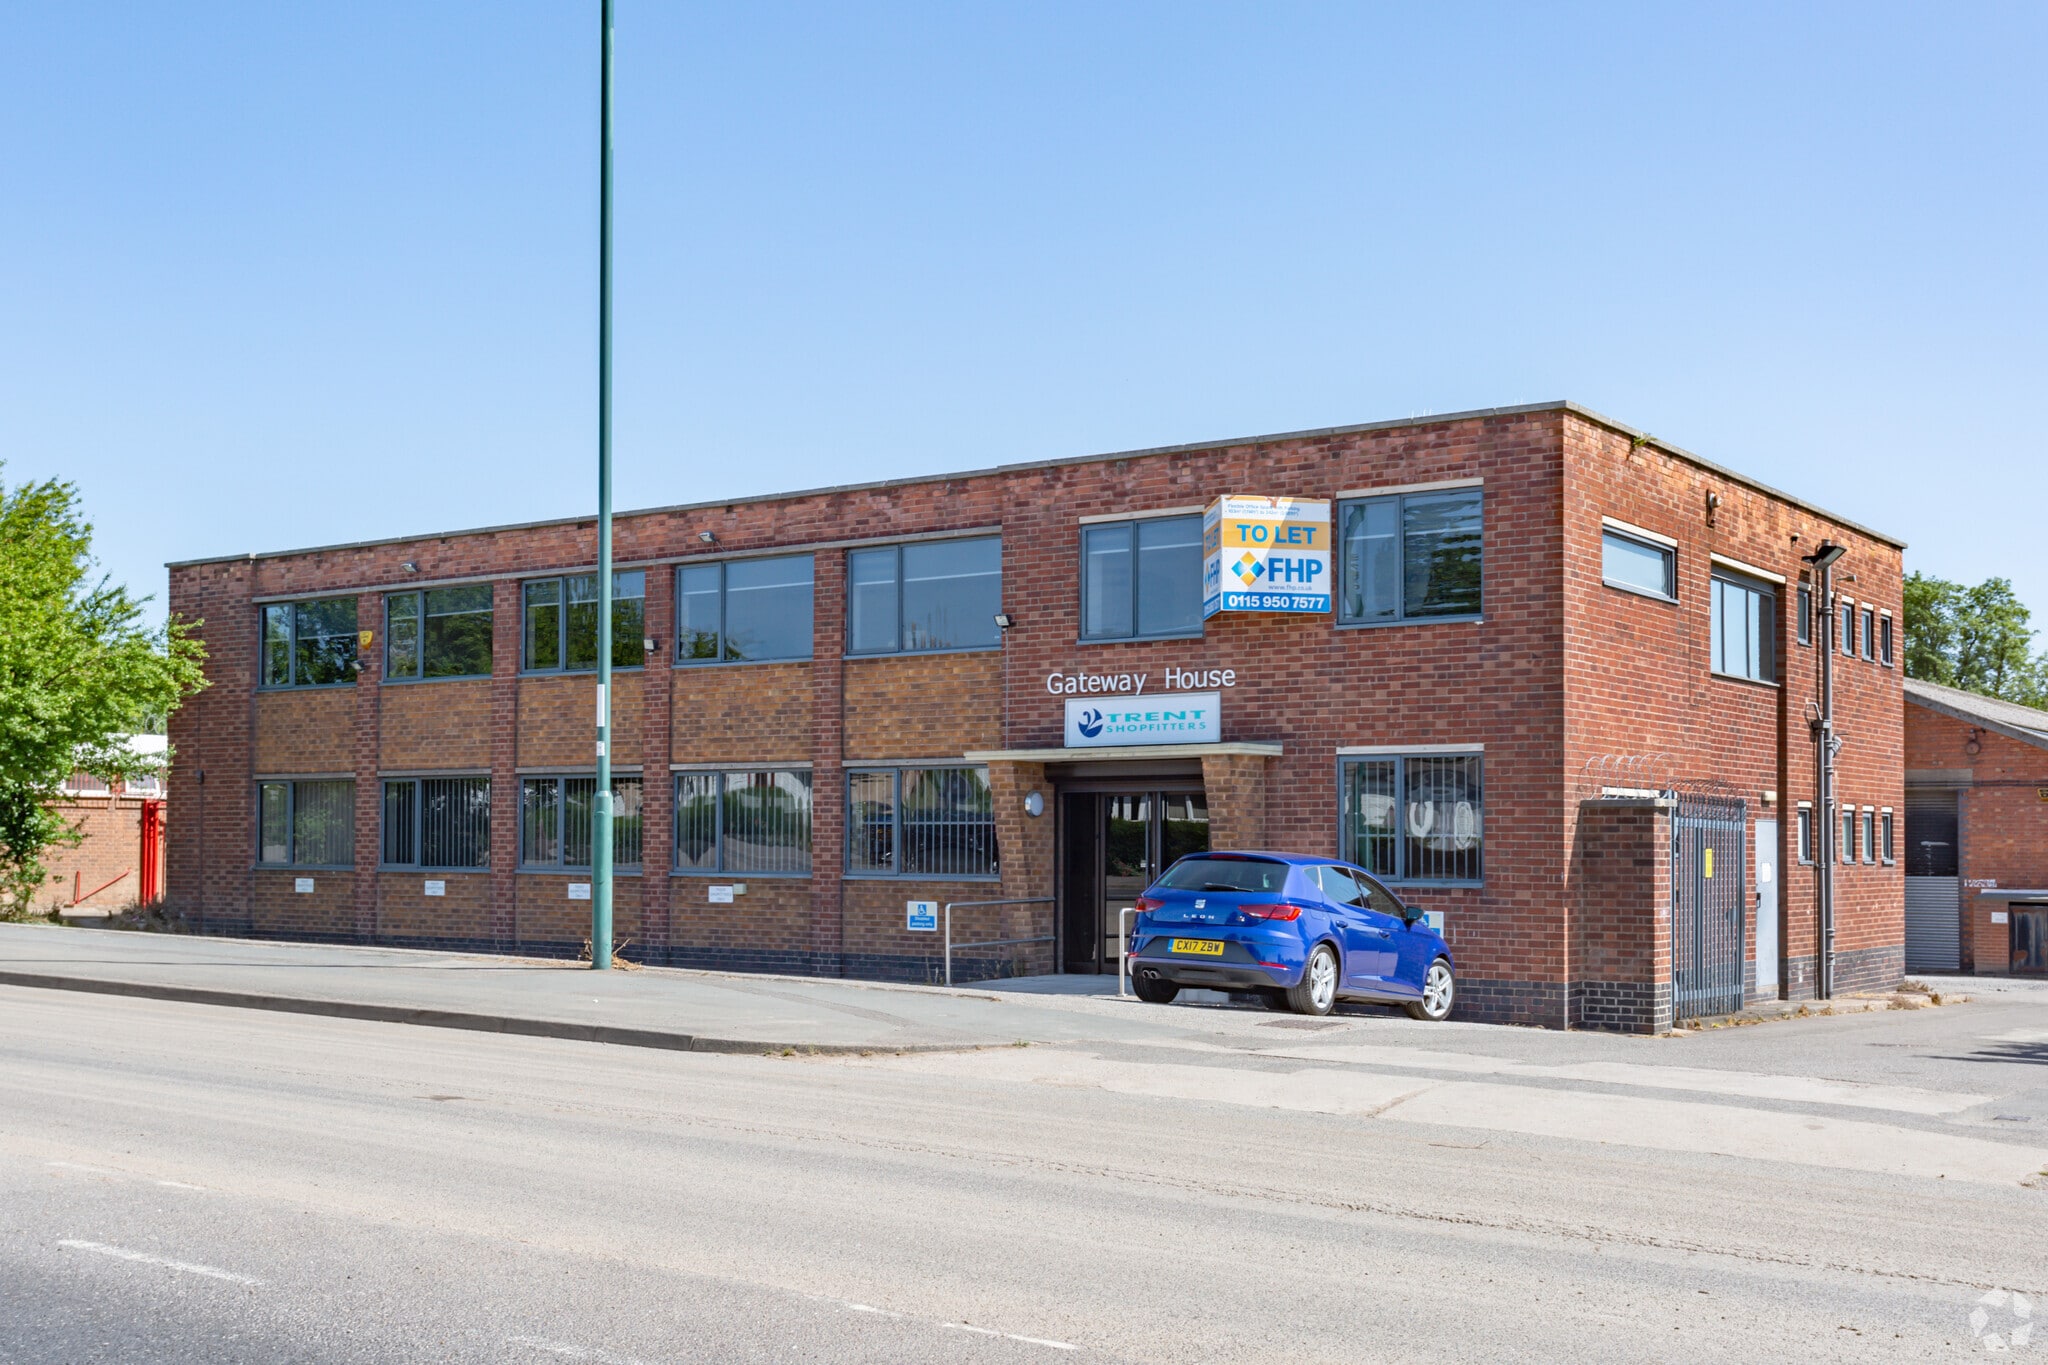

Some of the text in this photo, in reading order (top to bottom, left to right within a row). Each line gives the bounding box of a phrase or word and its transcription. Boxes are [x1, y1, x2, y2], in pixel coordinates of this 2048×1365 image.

[1236, 524, 1269, 543] TO
[1274, 525, 1318, 545] LET
[1267, 557, 1323, 583] FHP
[1268, 584, 1313, 592] www.fhp.co.uk
[1228, 594, 1325, 609] 0115 950 7577
[1046, 667, 1236, 696] Gateway House
[1106, 710, 1206, 723] TRENT
[1106, 721, 1206, 733] SHOPFITTERS
[1176, 940, 1220, 952] CX17 ZBW
